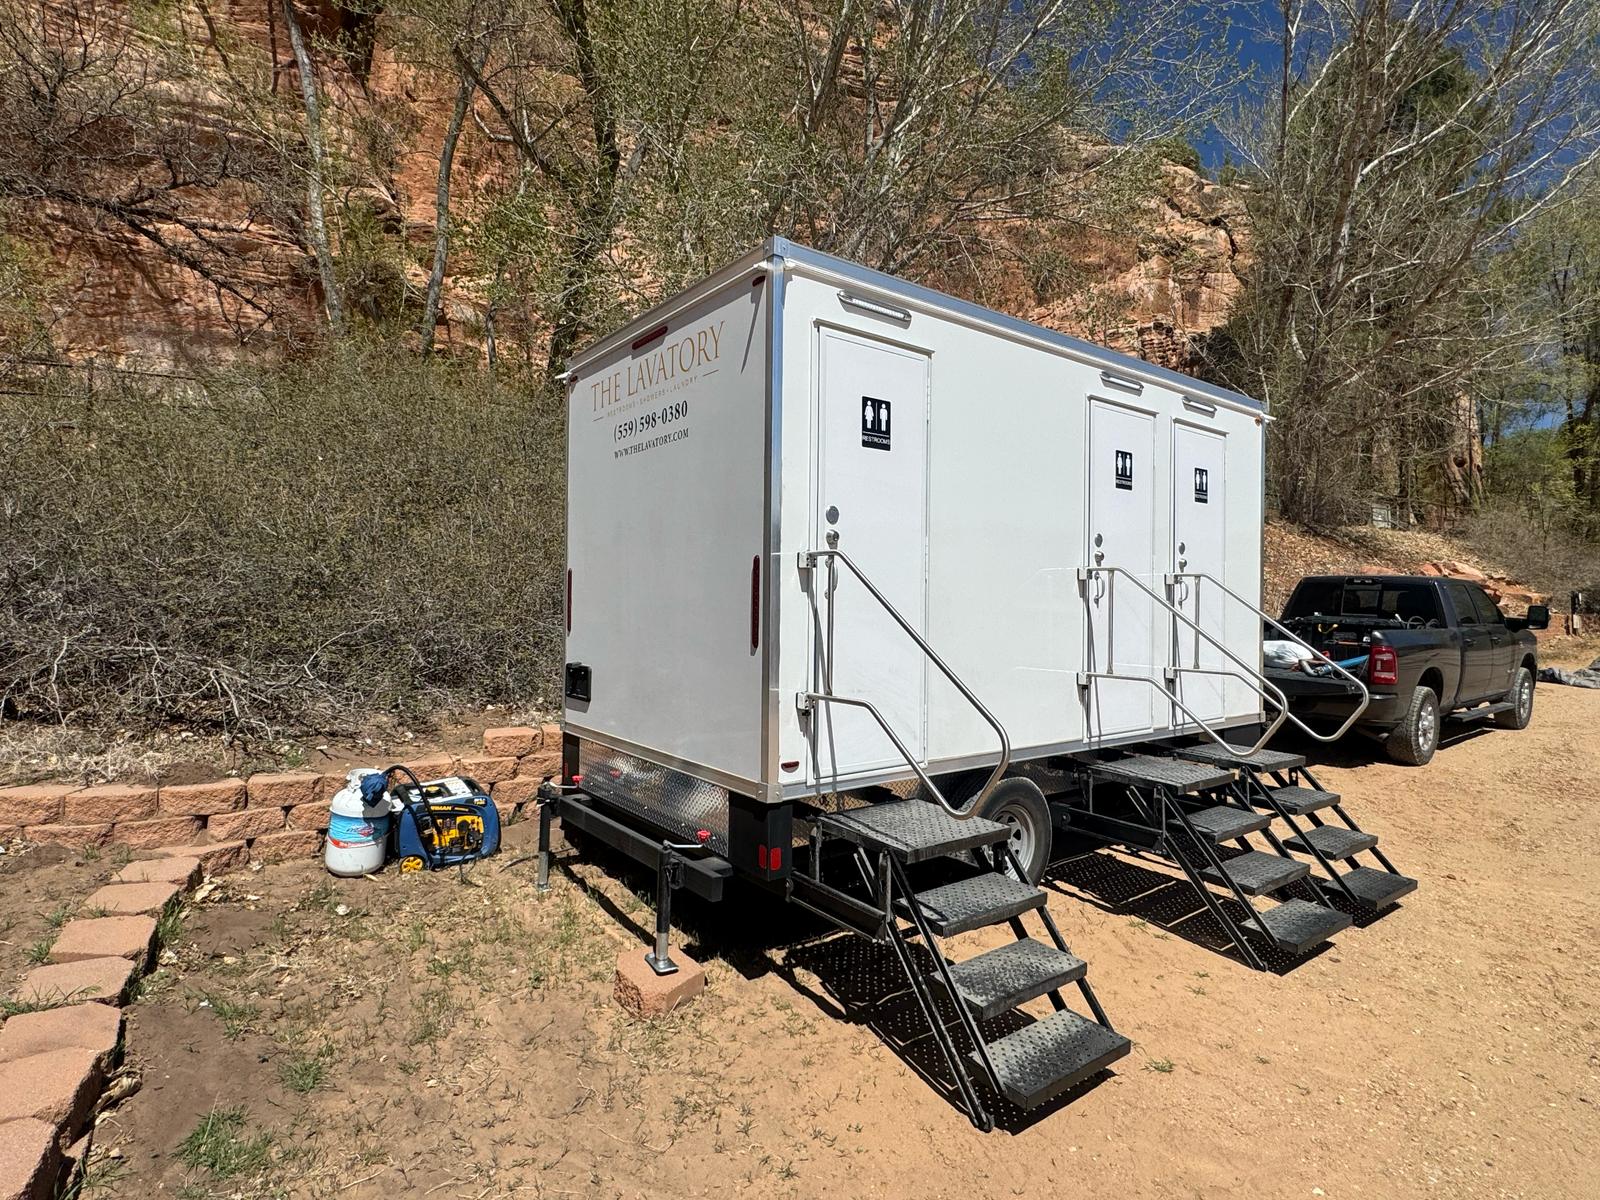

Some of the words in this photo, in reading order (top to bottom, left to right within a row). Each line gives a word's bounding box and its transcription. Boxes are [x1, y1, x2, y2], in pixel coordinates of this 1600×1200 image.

[591, 372, 621, 412] THE
[627, 320, 726, 397] LAVATORY
[614, 428, 689, 459] WWW.THELAVATORY.COM
